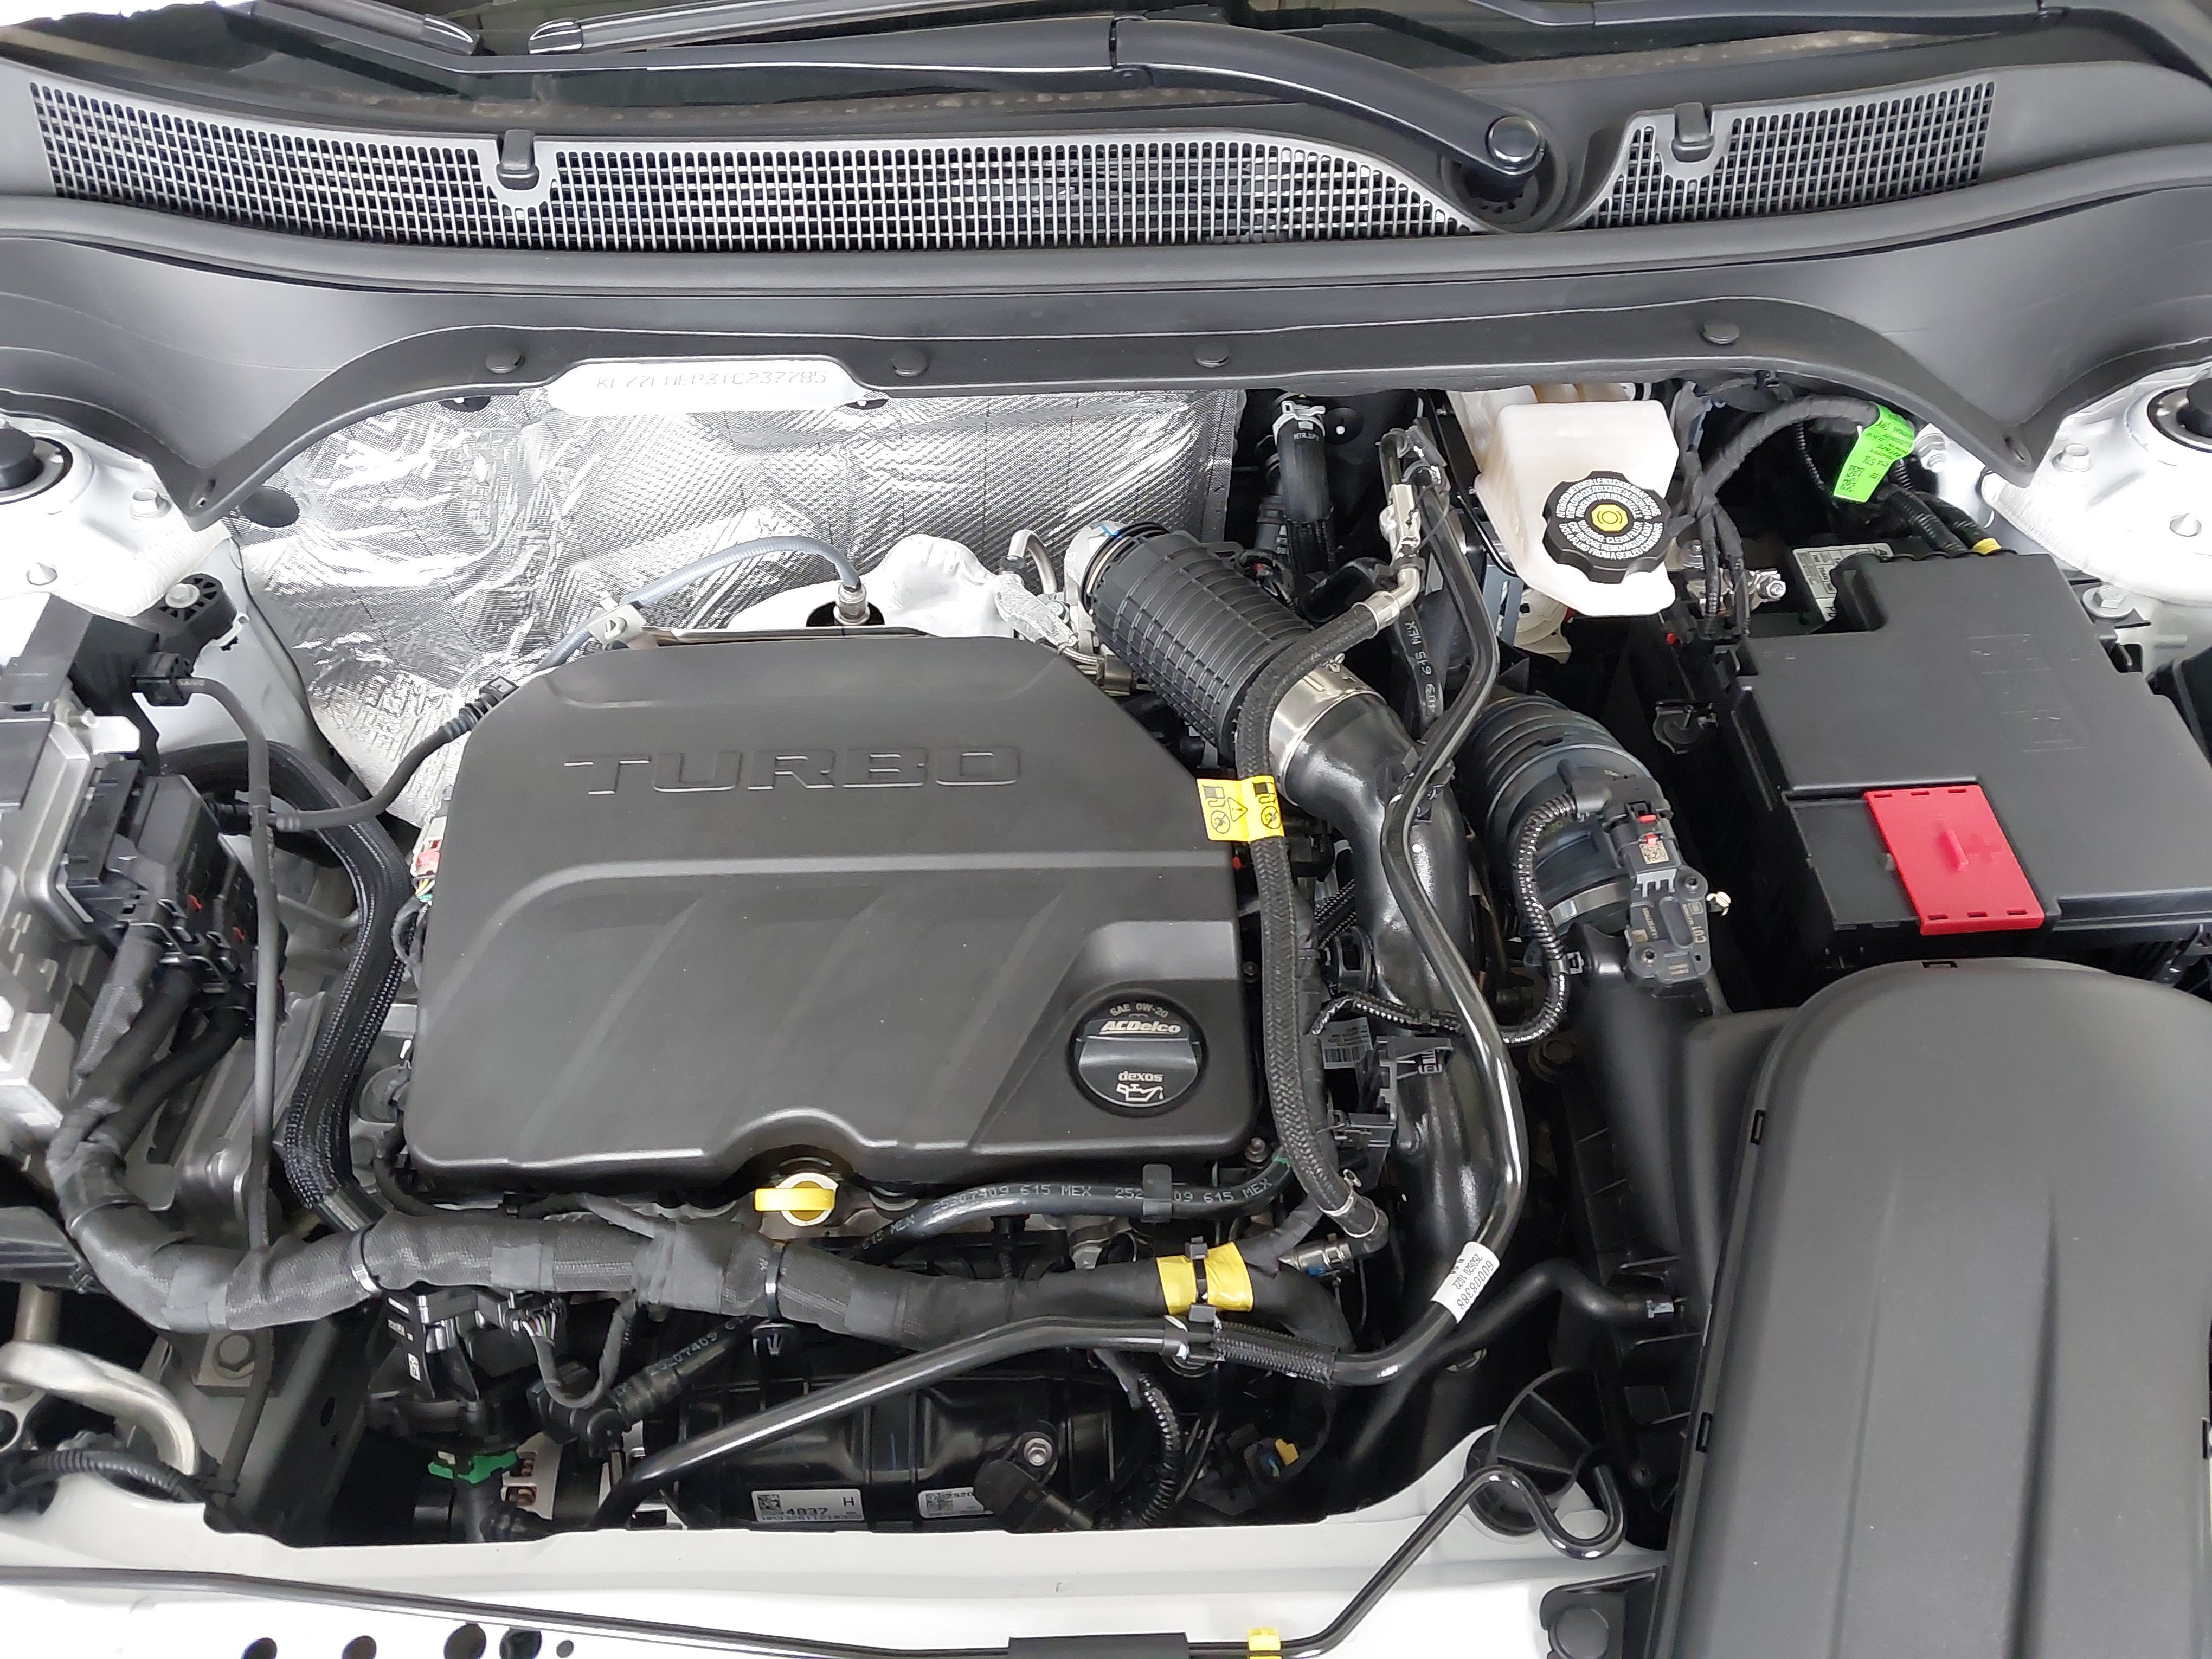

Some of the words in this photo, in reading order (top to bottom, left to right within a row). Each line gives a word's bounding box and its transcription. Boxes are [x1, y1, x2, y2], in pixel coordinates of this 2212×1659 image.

[1567, 522, 1581, 535] CAP
[1575, 531, 1602, 549] BEFORE
[1638, 522, 1655, 537] ONLY
[1606, 534, 1630, 545] CLEAN
[1568, 536, 1590, 551] FLUID
[1588, 547, 1610, 558] FROM
[1616, 545, 1643, 559] SEALED
[1405, 621, 1422, 645] MEX
[1414, 651, 1432, 674] 615
[564, 746, 1021, 795] TURBO
[1110, 1003, 1131, 1017] SAE
[1099, 1020, 1181, 1034] ACDelco
[1118, 1071, 1164, 1082] dexos
[1020, 1184, 1051, 1195] 615
[1061, 1185, 1091, 1197] MEX
[1203, 1191, 1234, 1203] 615
[1241, 1178, 1272, 1198] MEX
[843, 1497, 855, 1507] H
